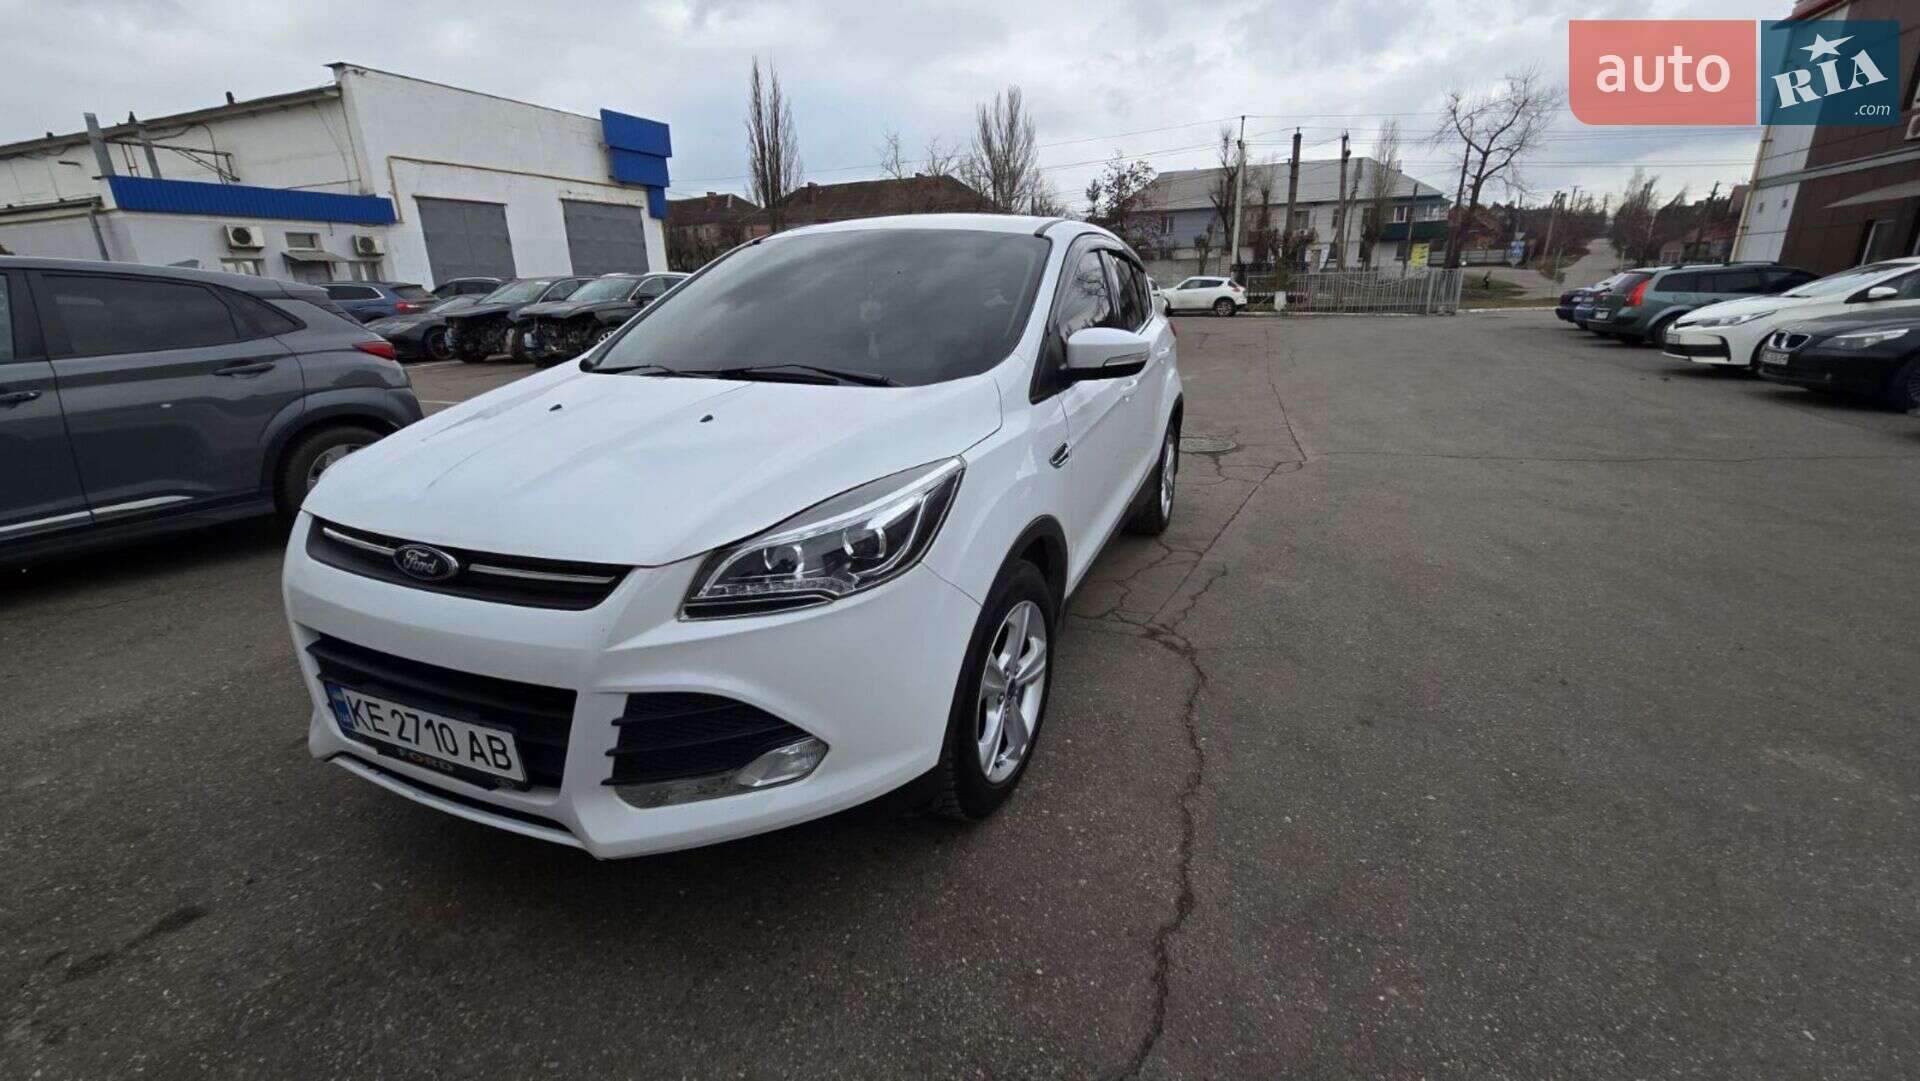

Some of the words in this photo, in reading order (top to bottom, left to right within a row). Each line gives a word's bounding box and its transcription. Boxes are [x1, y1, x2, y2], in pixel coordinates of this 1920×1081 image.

[403, 549, 438, 575] Ford
[346, 695, 390, 737] KE
[391, 709, 458, 757] 2710
[468, 730, 512, 771] AB
